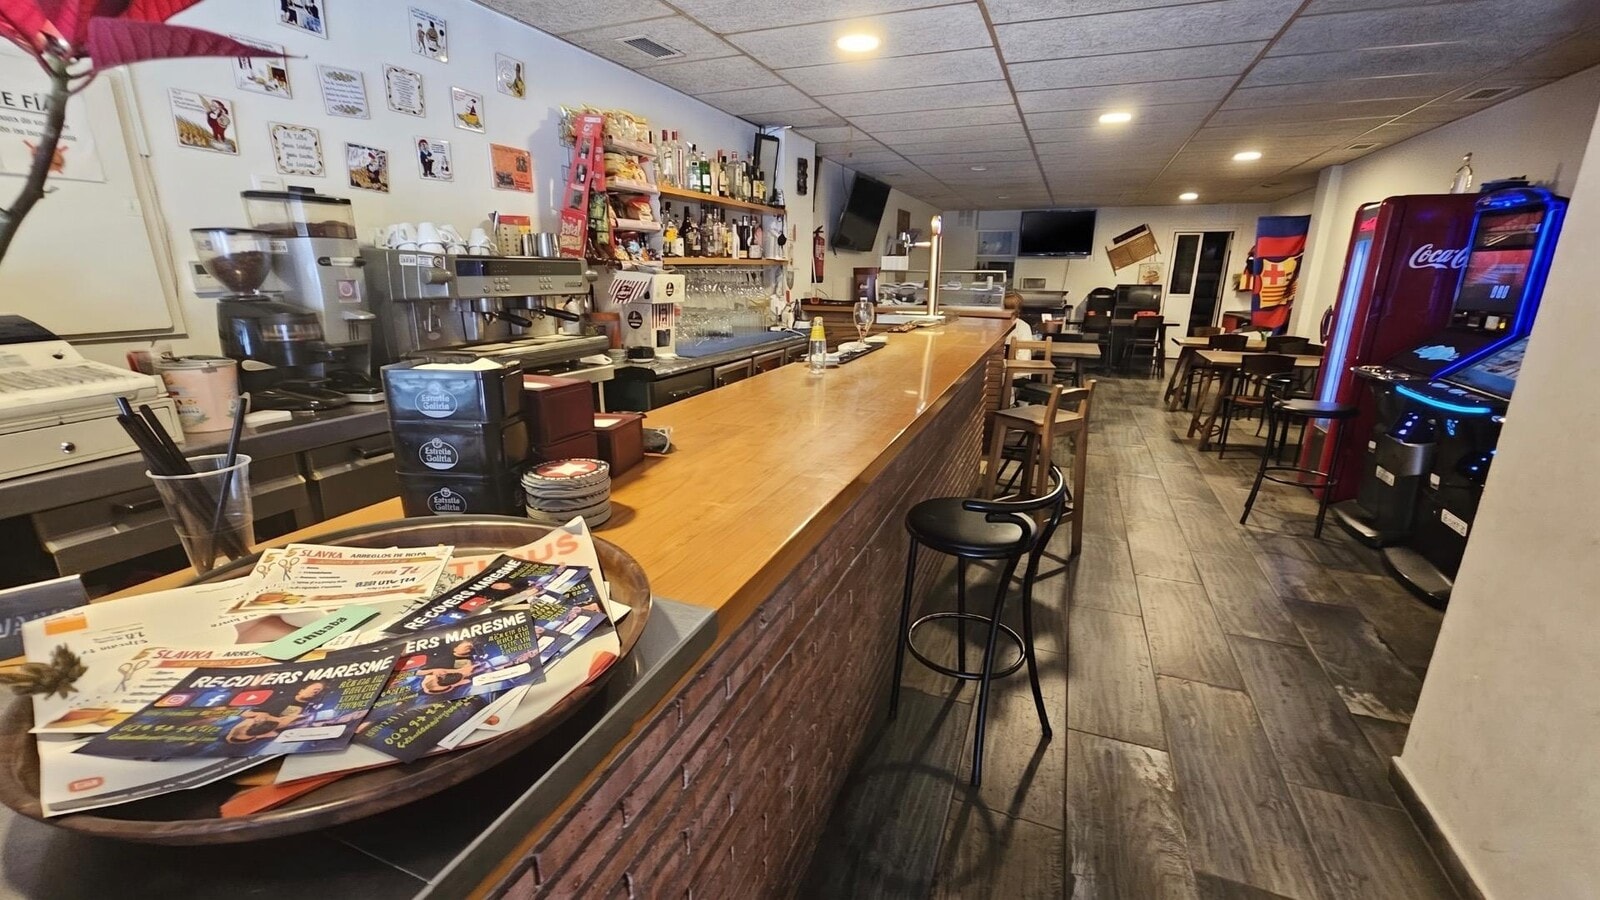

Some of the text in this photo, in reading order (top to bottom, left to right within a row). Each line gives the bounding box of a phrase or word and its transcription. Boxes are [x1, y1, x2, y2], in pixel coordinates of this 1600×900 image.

[300, 549, 343, 559] SLAVKA
[468, 559, 522, 592] MARESME
[445, 611, 527, 644] MARESME
[153, 649, 213, 659] SLAVKA
[302, 655, 395, 682] MARESME
